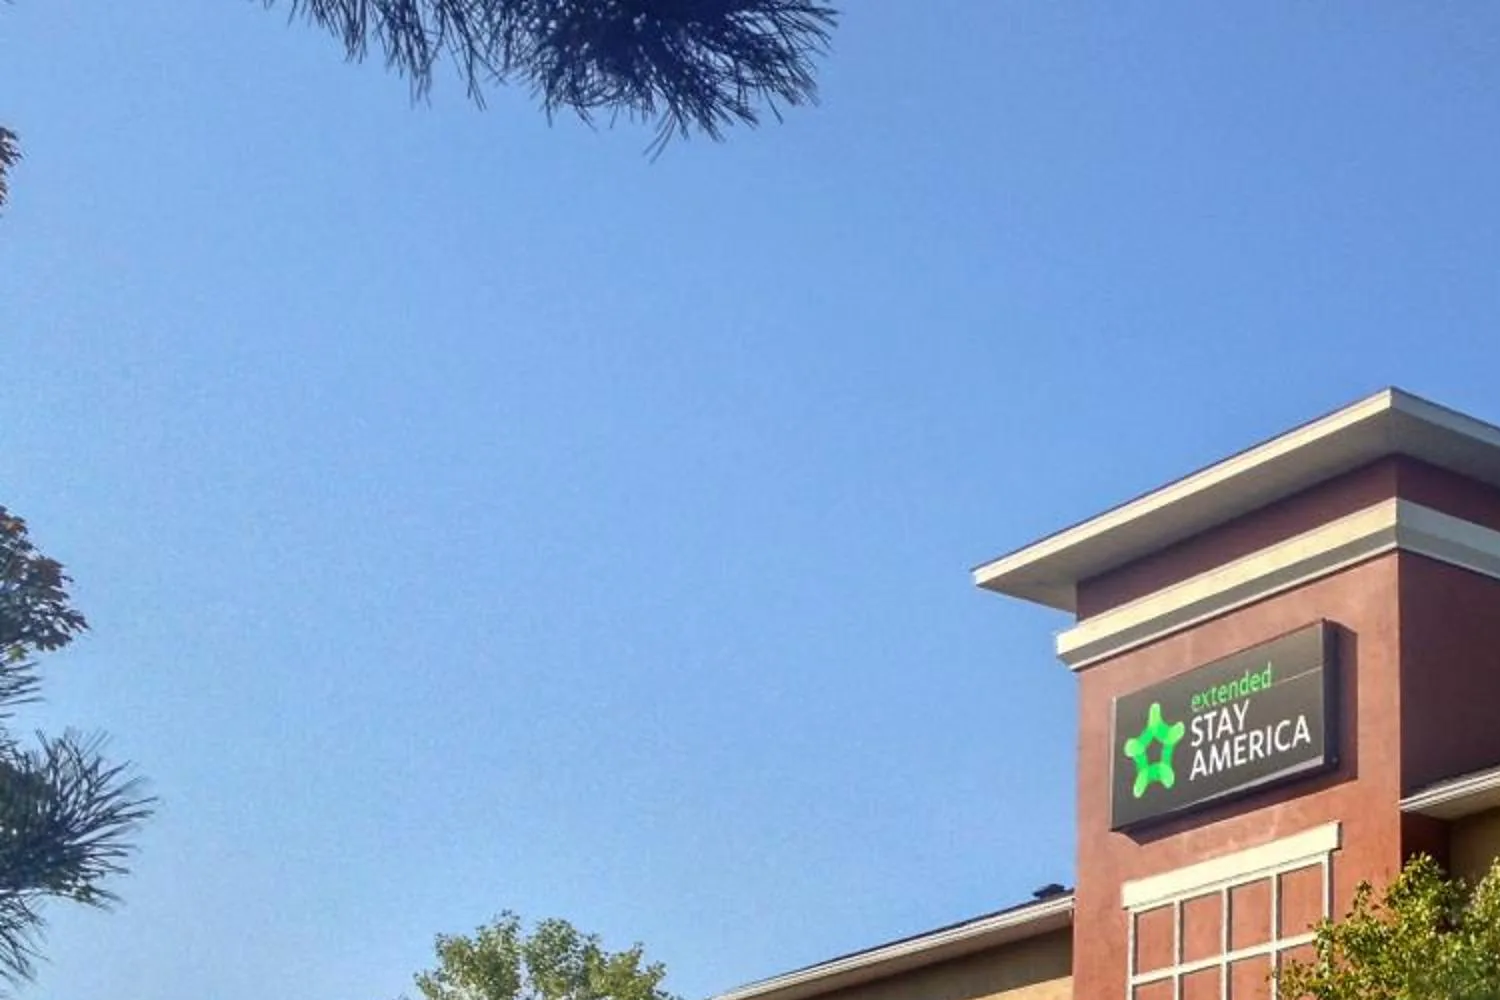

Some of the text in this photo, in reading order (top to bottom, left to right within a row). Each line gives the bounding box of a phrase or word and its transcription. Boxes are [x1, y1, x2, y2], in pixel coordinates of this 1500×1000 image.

[1190, 661, 1273, 713] extended
[1189, 714, 1312, 782] AMERICA
[1190, 699, 1250, 747] STAY
